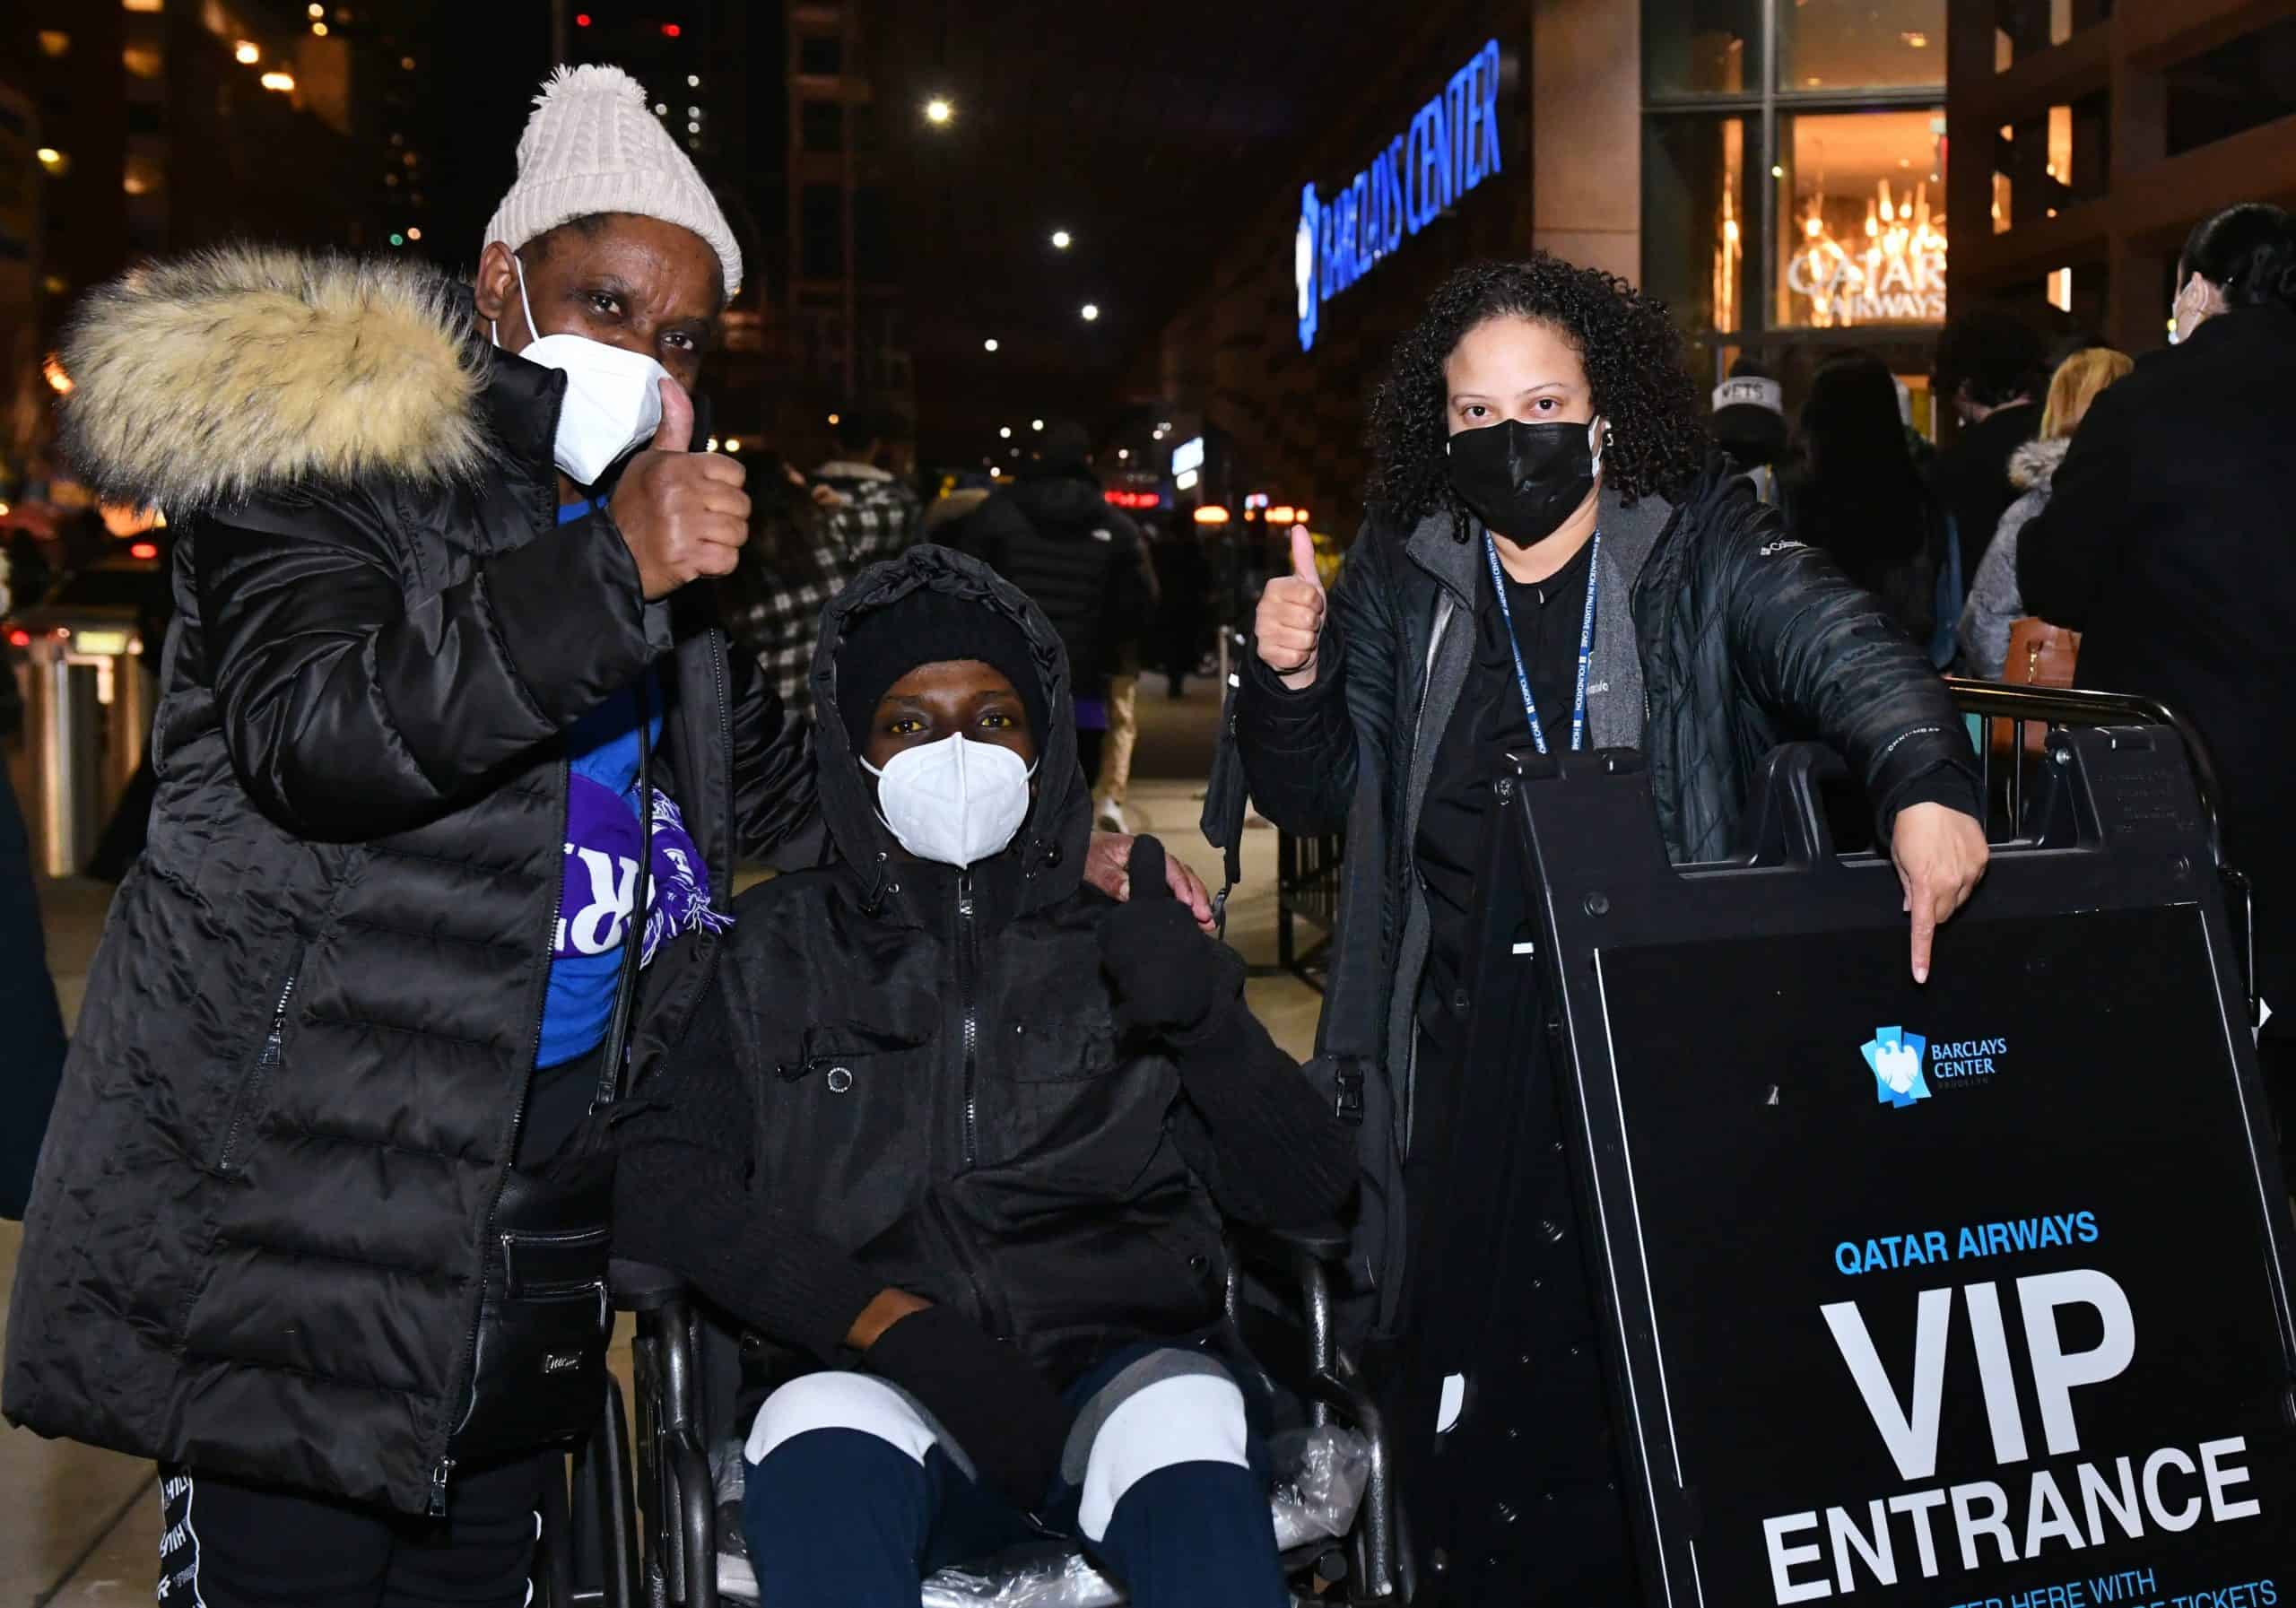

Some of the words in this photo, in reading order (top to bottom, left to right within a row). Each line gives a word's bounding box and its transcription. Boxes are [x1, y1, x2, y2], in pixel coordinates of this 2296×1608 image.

[1405, 38, 1502, 237] CENTER
[1787, 253, 1946, 295] QATAR
[1831, 292, 1946, 319] AIRWAYS
[1931, 1038, 2007, 1060] BARCLAYS
[1934, 1058, 1996, 1079] CENTER
[1835, 1231, 1949, 1274] QATAR
[1958, 1211, 2099, 1258] AIRWAYS
[1819, 1268, 2135, 1482] VIP
[1763, 1437, 2261, 1605] ENTRANCE
[2011, 1582, 2085, 1608] HERE
[2089, 1568, 2156, 1604] WITH
